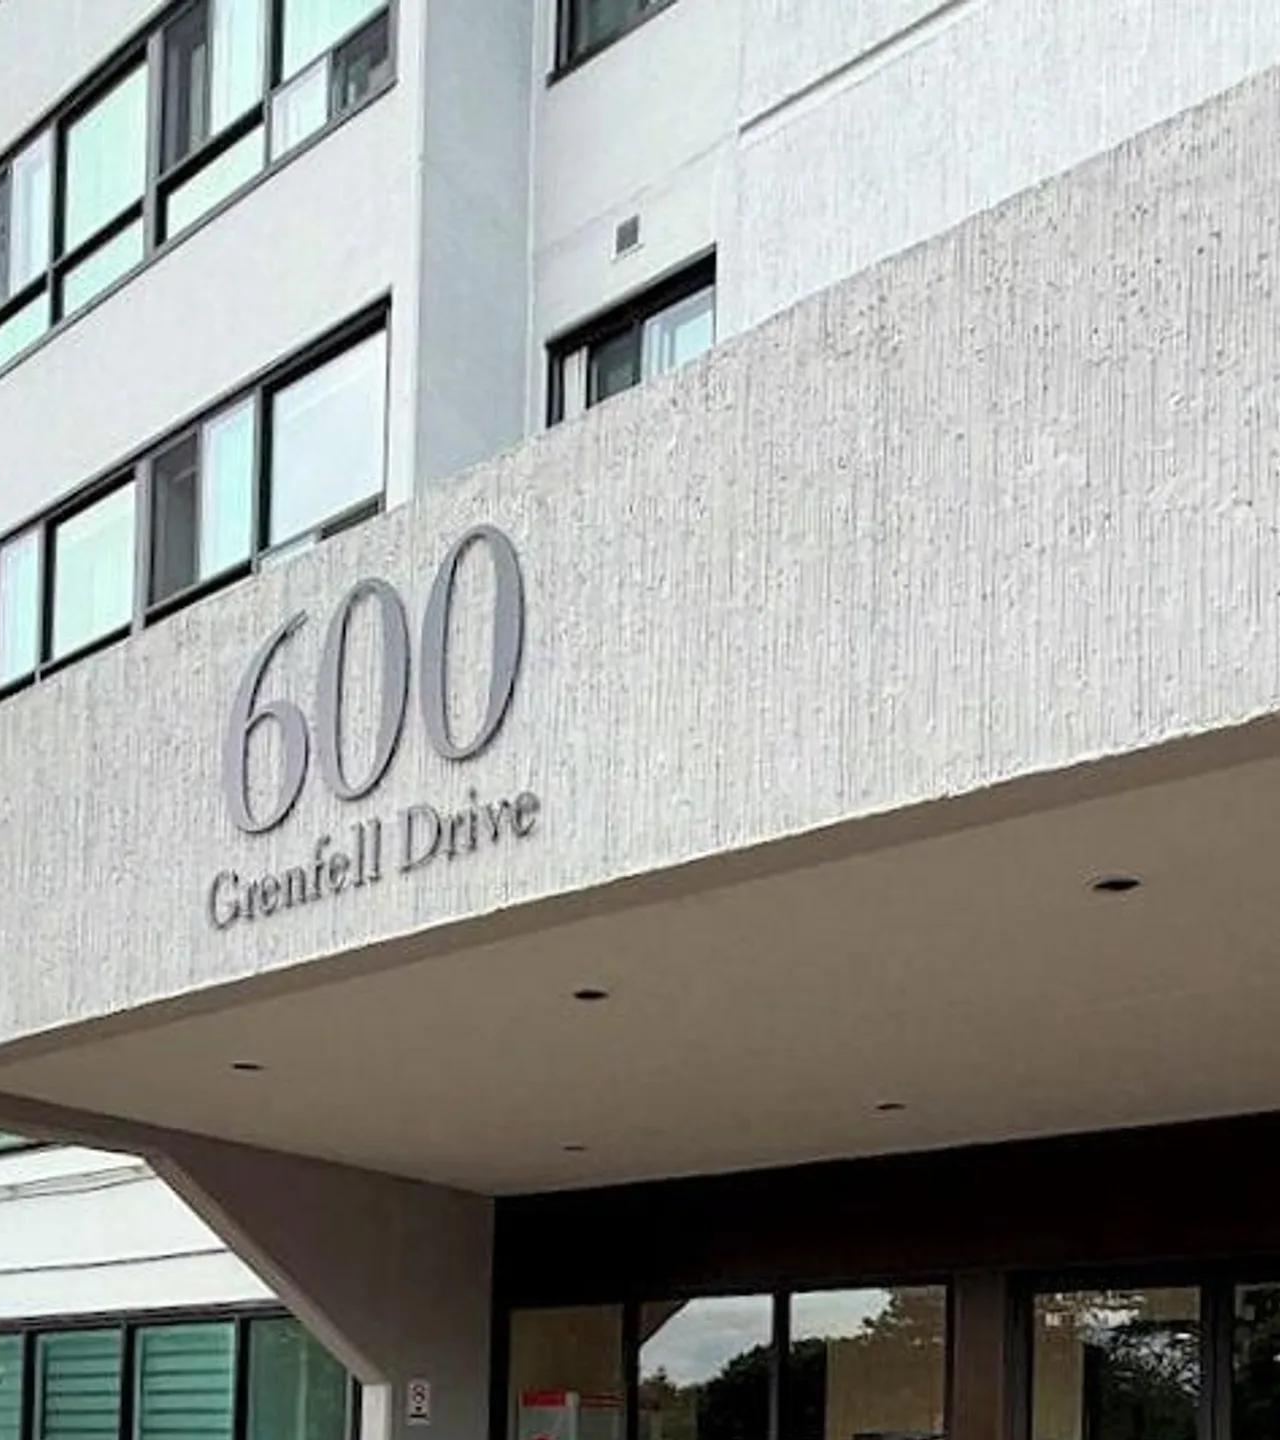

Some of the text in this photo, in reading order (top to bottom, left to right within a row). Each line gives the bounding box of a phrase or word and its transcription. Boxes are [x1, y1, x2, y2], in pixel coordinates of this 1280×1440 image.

[221, 523, 526, 836] 600
[208, 787, 542, 930] Grenfell Drive
